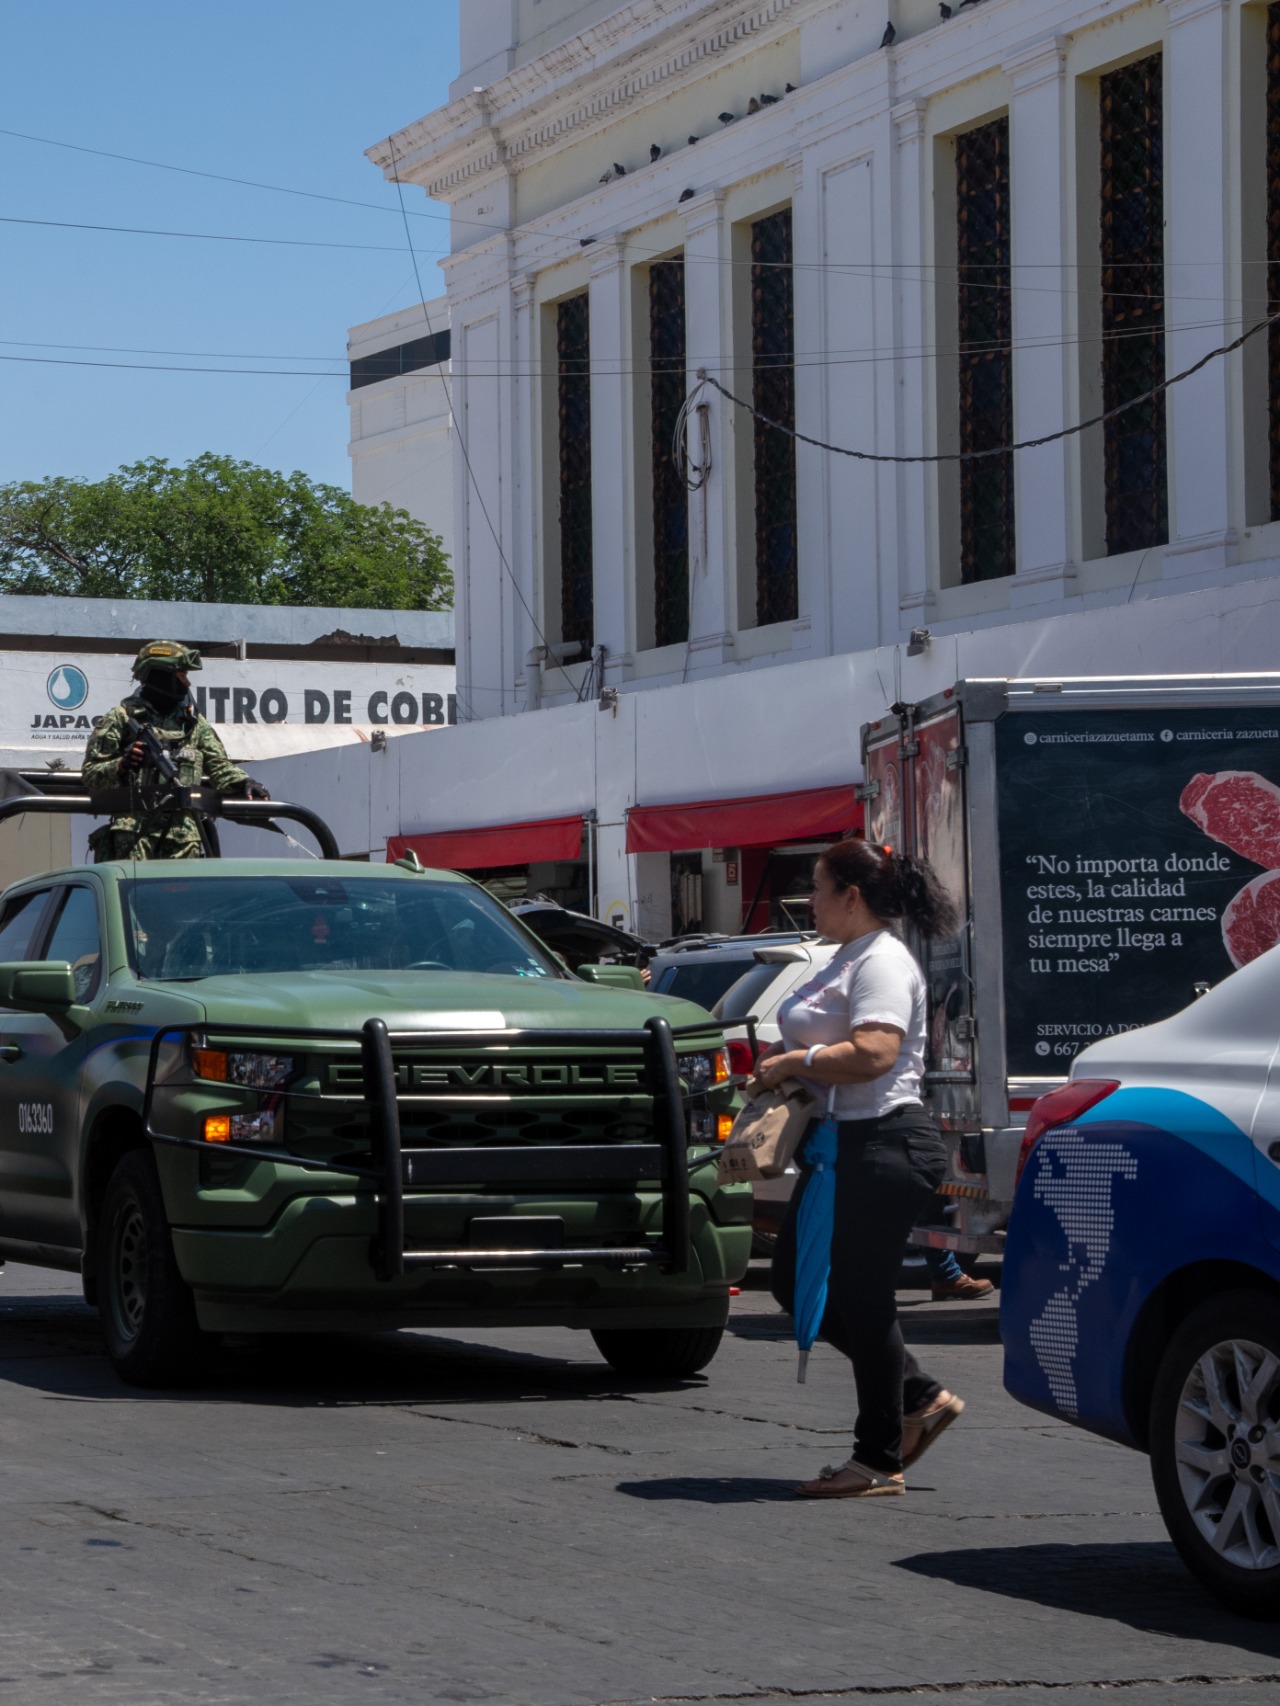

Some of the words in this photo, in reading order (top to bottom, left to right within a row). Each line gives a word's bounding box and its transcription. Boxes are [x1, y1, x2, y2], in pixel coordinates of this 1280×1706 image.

[304, 689, 352, 724] DE
[1039, 731, 1155, 743] carniceriazazuetamx
[1176, 728, 1234, 740] carniceria
[1235, 729, 1279, 739] zazueta
[1026, 855, 1070, 874] “No
[1076, 854, 1159, 878] importa
[1164, 852, 1230, 872] donde
[1026, 885, 1082, 902] estes,
[1087, 879, 1105, 898] la
[1111, 877, 1186, 897] calidad
[1028, 904, 1053, 924] de
[1058, 907, 1144, 924] nuestras
[1150, 906, 1217, 922] carnes
[1028, 929, 1112, 952] siempre
[1117, 928, 1166, 951] llega
[1171, 932, 1183, 947] a
[1030, 957, 1051, 974] tu
[1057, 952, 1120, 973] mesa”
[1037, 1024, 1102, 1036] SERVICIO
[1105, 1024, 1115, 1035] A
[1054, 1042, 1079, 1056] 667
[19, 1103, 53, 1134] 0163360
